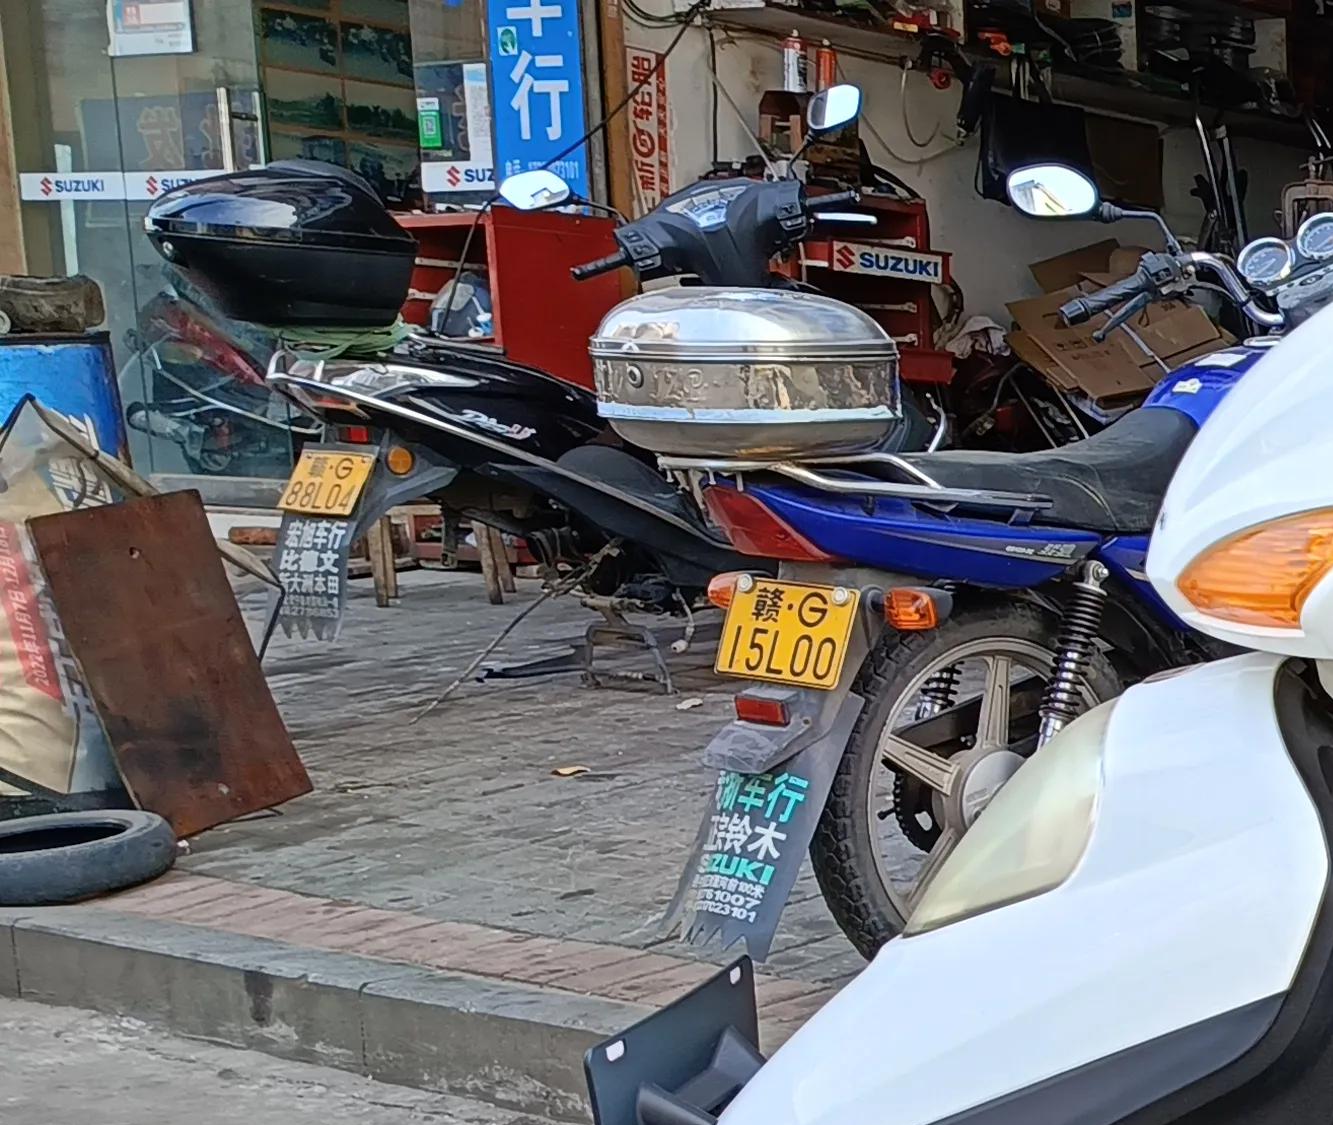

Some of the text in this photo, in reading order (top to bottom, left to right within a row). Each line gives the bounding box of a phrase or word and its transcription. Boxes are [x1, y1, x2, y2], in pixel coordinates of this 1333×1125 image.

[55, 179, 105, 192] SUZUKI
[859, 252, 939, 277] SUZUKI
[285, 481, 356, 511] 88L04
[728, 625, 837, 681] 15L00
